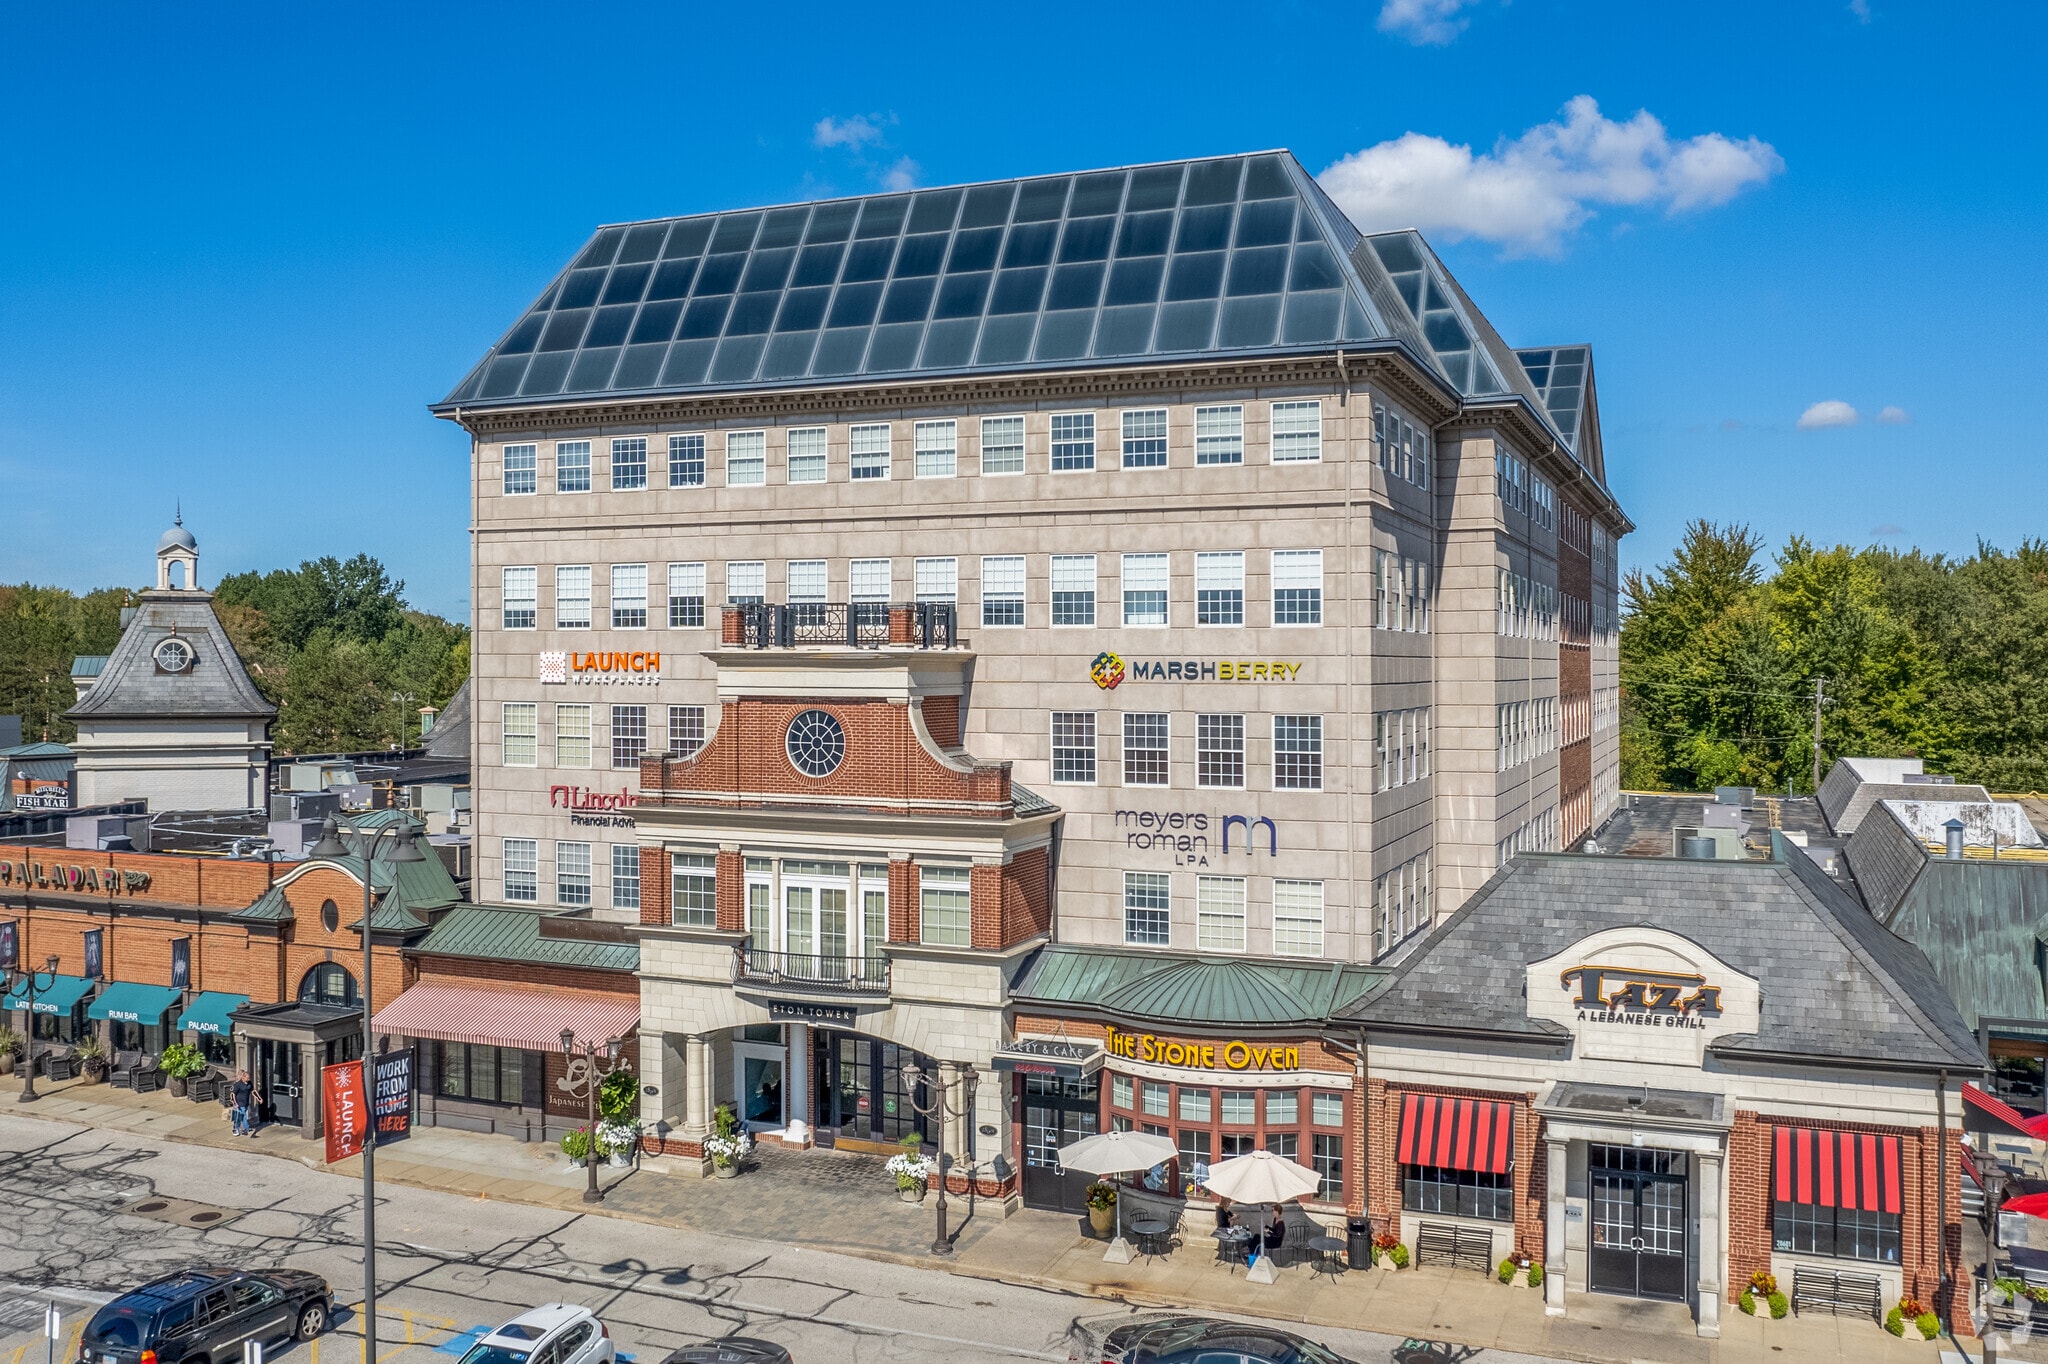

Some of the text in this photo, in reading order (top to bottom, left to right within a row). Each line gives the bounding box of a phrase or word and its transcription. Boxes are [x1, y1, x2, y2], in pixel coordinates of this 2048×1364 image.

[572, 651, 660, 672] LAUNCH
[1133, 661, 1302, 681] MARSHBERRY
[572, 674, 660, 686] WORKPLACES
[16, 797, 40, 808] FISH
[571, 815, 610, 827] Financial
[1115, 810, 1208, 832] meyers
[1127, 832, 1208, 852] roman
[1175, 854, 1209, 867] LPA
[0, 861, 120, 890] PALADAR
[1560, 964, 1724, 1016] TAZA
[109, 1010, 138, 1020] RUM BAR
[773, 1005, 850, 1019] ETON TOWER
[1577, 1010, 1706, 1029] A LEBANESE GRILL
[188, 1021, 219, 1031] PALADAR
[995, 1040, 1038, 1053] BAKERY
[1042, 1045, 1049, 1054] &
[1105, 1025, 1299, 1071] THE STONE OVEN
[377, 1057, 409, 1080] WORK
[376, 1075, 408, 1097] FROM
[376, 1092, 408, 1115] HOME
[341, 1090, 354, 1155] LAUNCH
[378, 1116, 408, 1131] HERE
